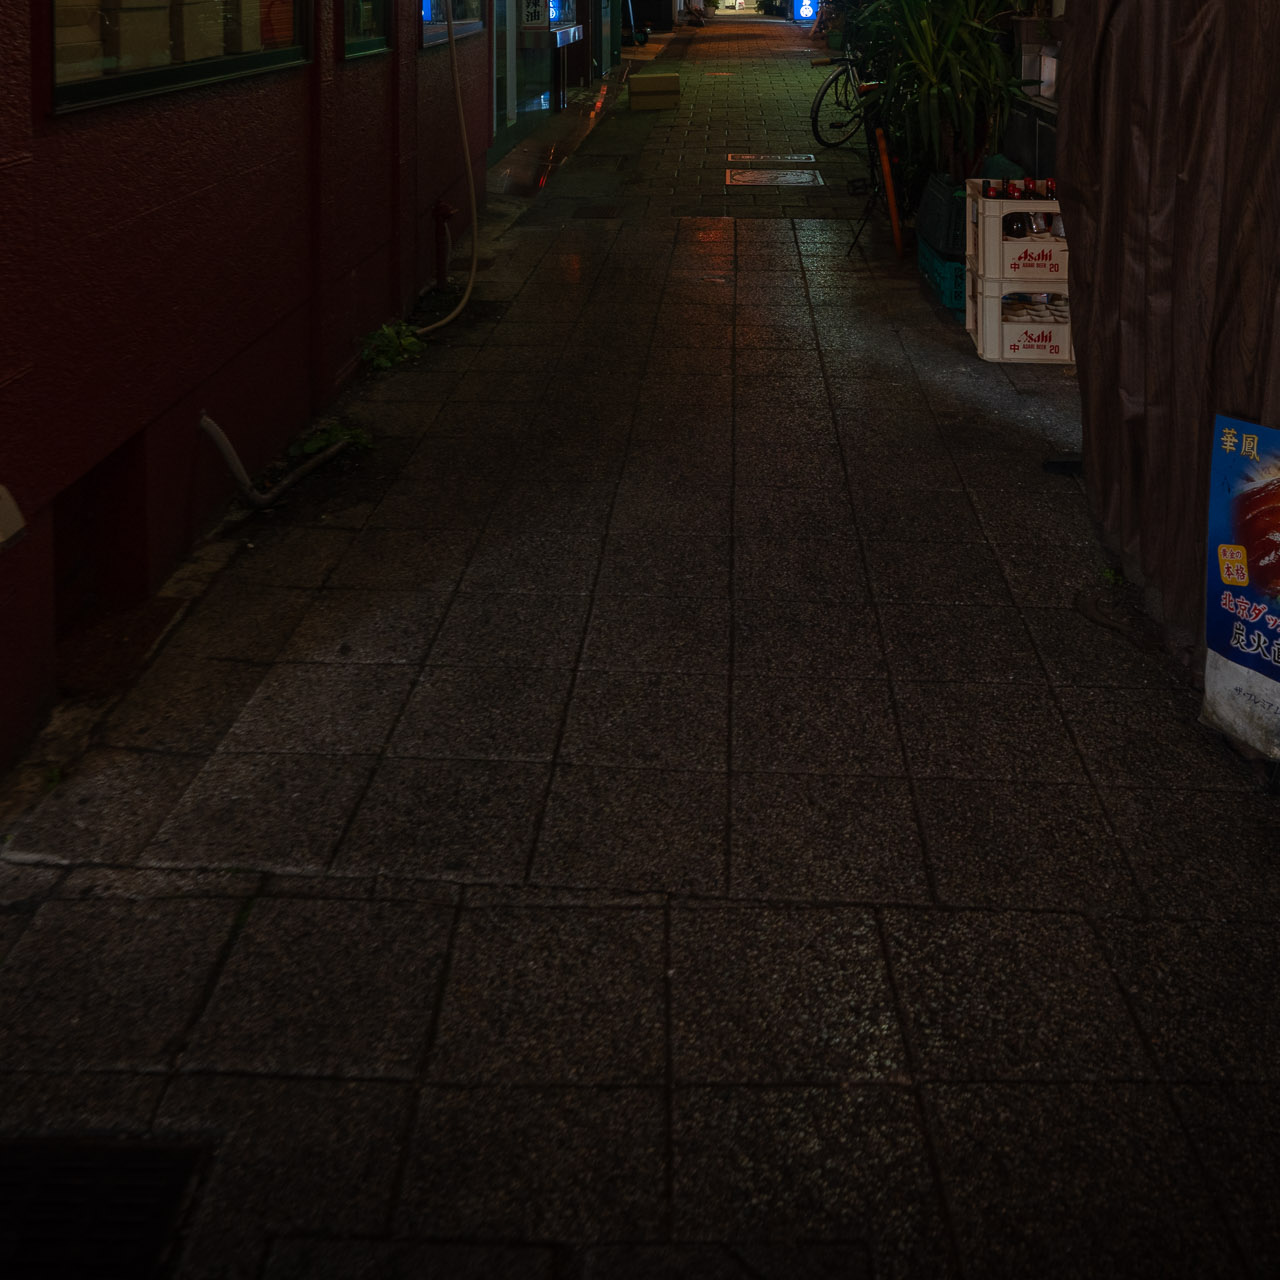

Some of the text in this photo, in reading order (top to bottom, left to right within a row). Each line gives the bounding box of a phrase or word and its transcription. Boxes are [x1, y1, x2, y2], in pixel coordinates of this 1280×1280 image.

[1018, 248, 1053, 261] Asahi
[1010, 262, 1020, 272] 中
[1049, 263, 1060, 273] 20
[1018, 330, 1053, 343] Asahi
[1009, 343, 1020, 353] 中
[1049, 345, 1060, 354] 20
[1223, 562, 1248, 582] 本格
